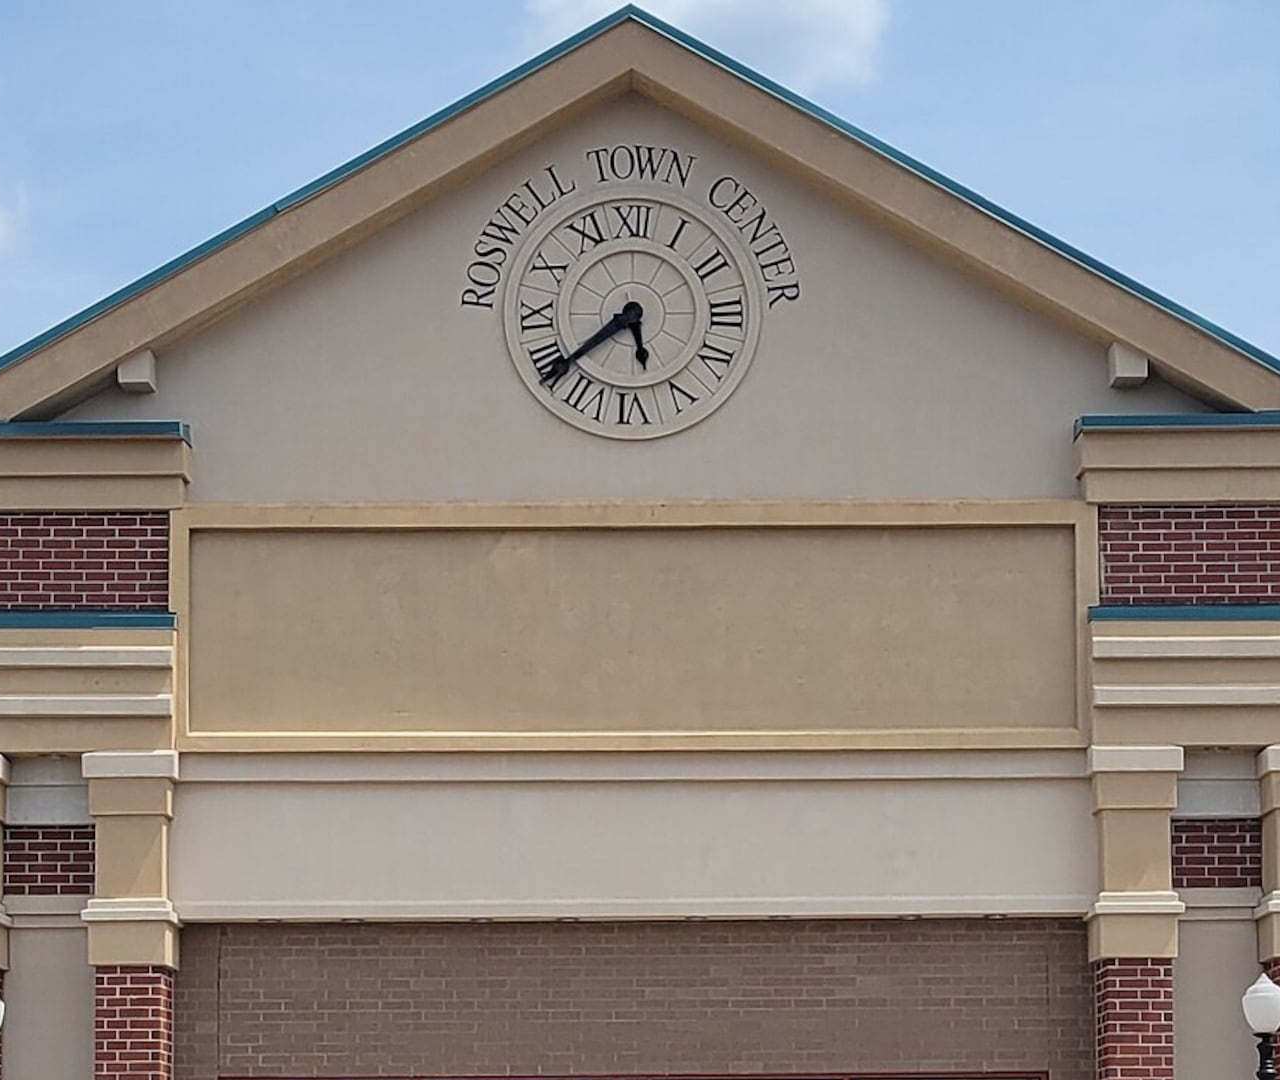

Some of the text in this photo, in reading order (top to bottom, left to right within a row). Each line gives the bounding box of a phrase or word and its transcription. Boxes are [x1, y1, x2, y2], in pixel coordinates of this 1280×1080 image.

[461, 144, 800, 309] ROSWELL TOWN CENTER
[565, 211, 609, 255] XI
[612, 205, 654, 239] XII
[665, 217, 691, 251] I
[529, 251, 569, 283] X
[693, 247, 730, 283] II
[520, 299, 555, 334] IX
[708, 295, 744, 331] III
[698, 340, 736, 382] IV
[561, 372, 605, 423] VII
[615, 392, 652, 425] VI
[667, 380, 700, 413] V
